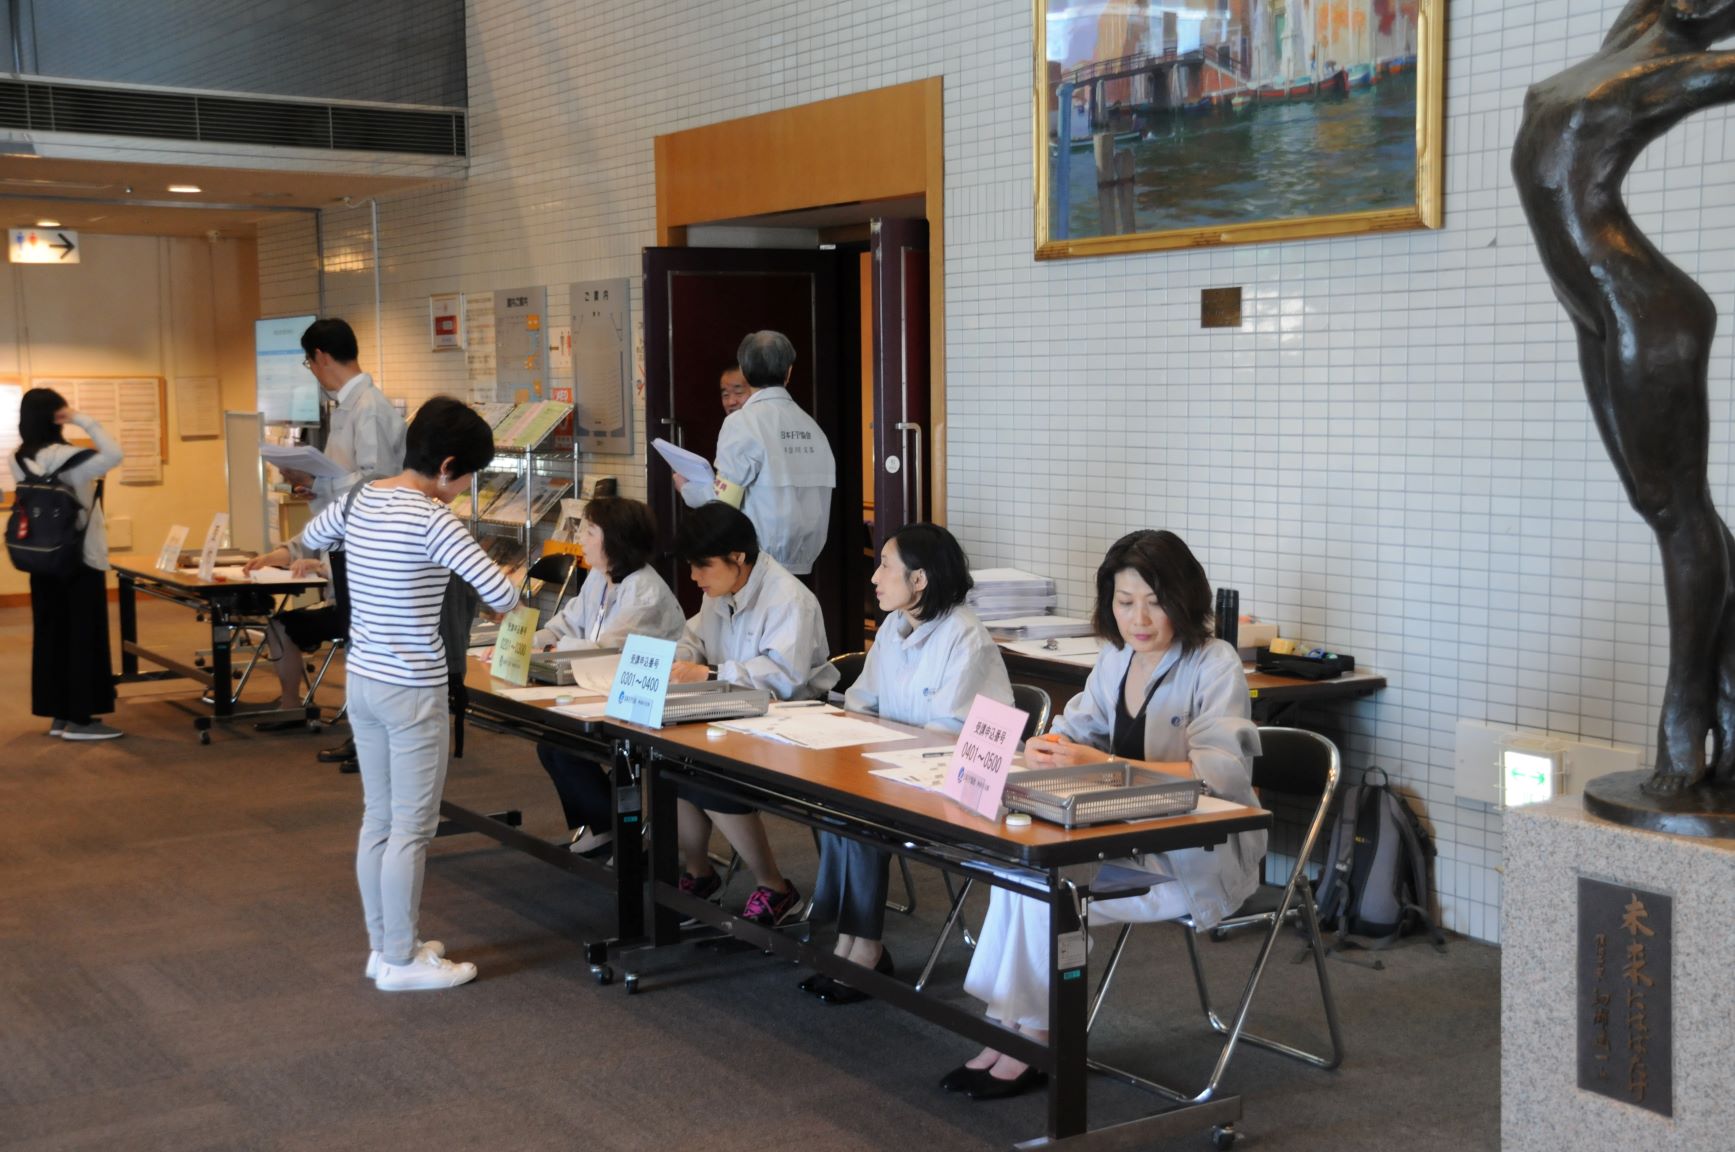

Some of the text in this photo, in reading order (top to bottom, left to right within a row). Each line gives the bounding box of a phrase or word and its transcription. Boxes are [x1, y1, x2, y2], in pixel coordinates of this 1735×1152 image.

[631, 654, 660, 669] 受講申込番号
[974, 722, 1007, 744] 受講申込番号
